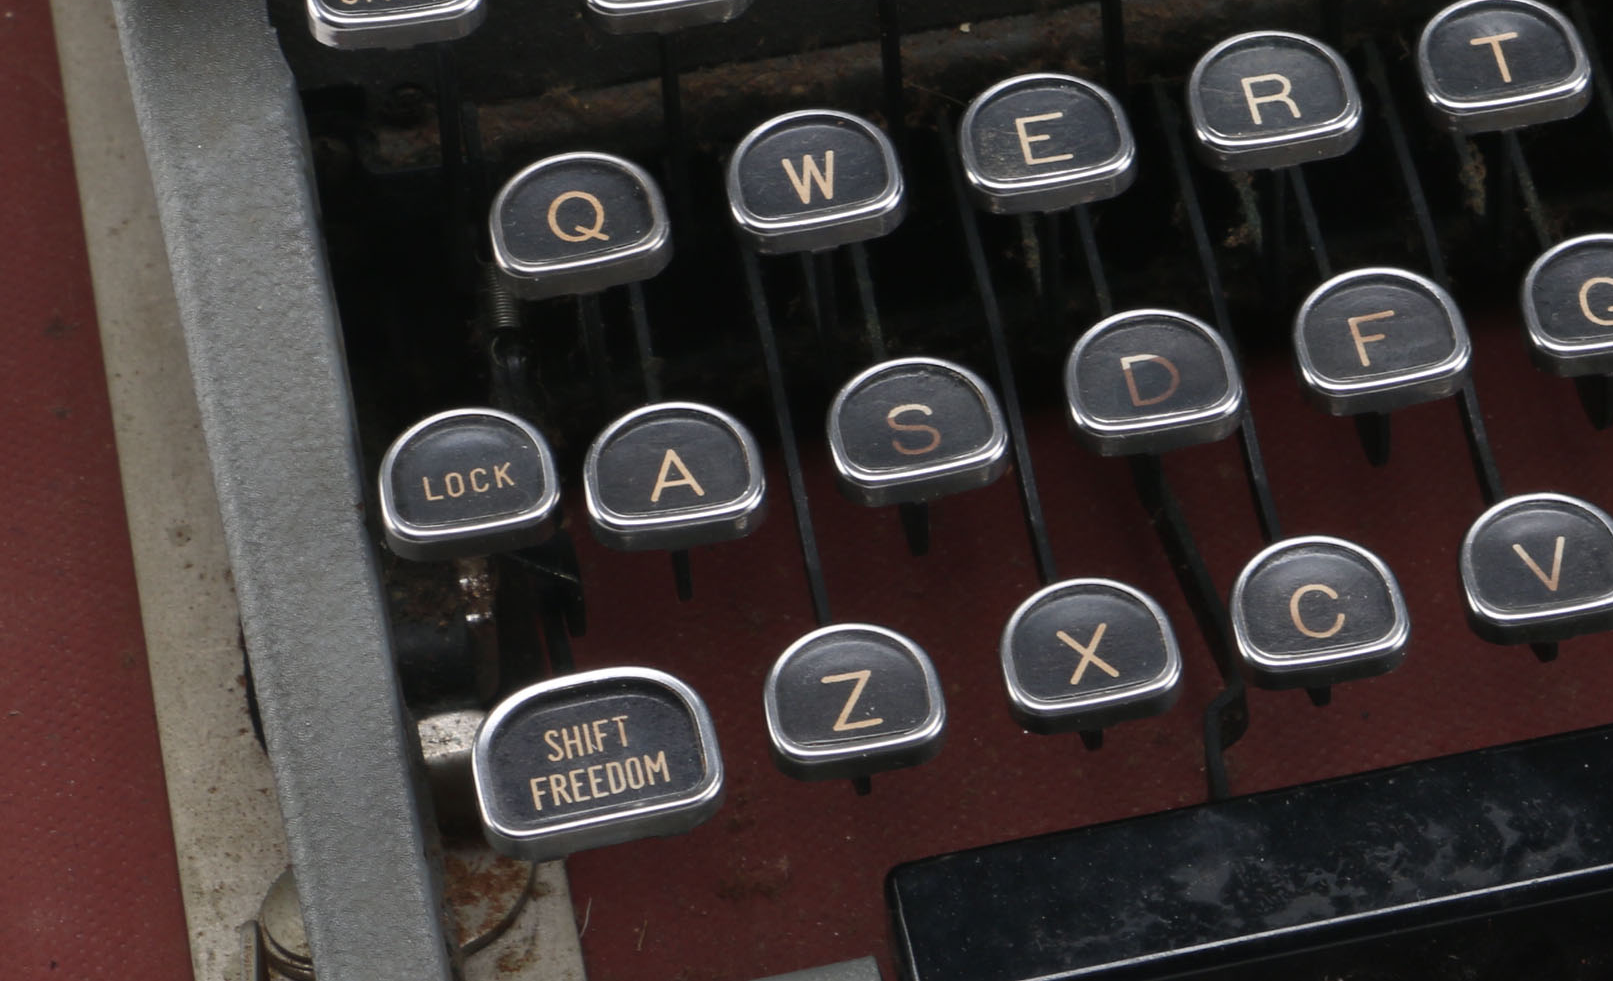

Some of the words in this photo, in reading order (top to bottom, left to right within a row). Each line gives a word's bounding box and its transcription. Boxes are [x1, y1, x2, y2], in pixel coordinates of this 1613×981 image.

[1469, 31, 1519, 83] T
[1240, 72, 1302, 125] R
[1014, 111, 1074, 166] E
[781, 149, 834, 205] W
[546, 190, 610, 243] Q
[1346, 309, 1395, 367] F
[1119, 352, 1180, 407] D
[886, 403, 941, 455] S
[422, 461, 515, 501] LOCK
[650, 448, 705, 503] A
[1511, 535, 1566, 592] V
[1288, 583, 1346, 639] C
[1055, 622, 1120, 685] X
[820, 669, 884, 732] Z
[543, 714, 629, 762] SHIFT
[529, 750, 672, 812] FREEDOM
